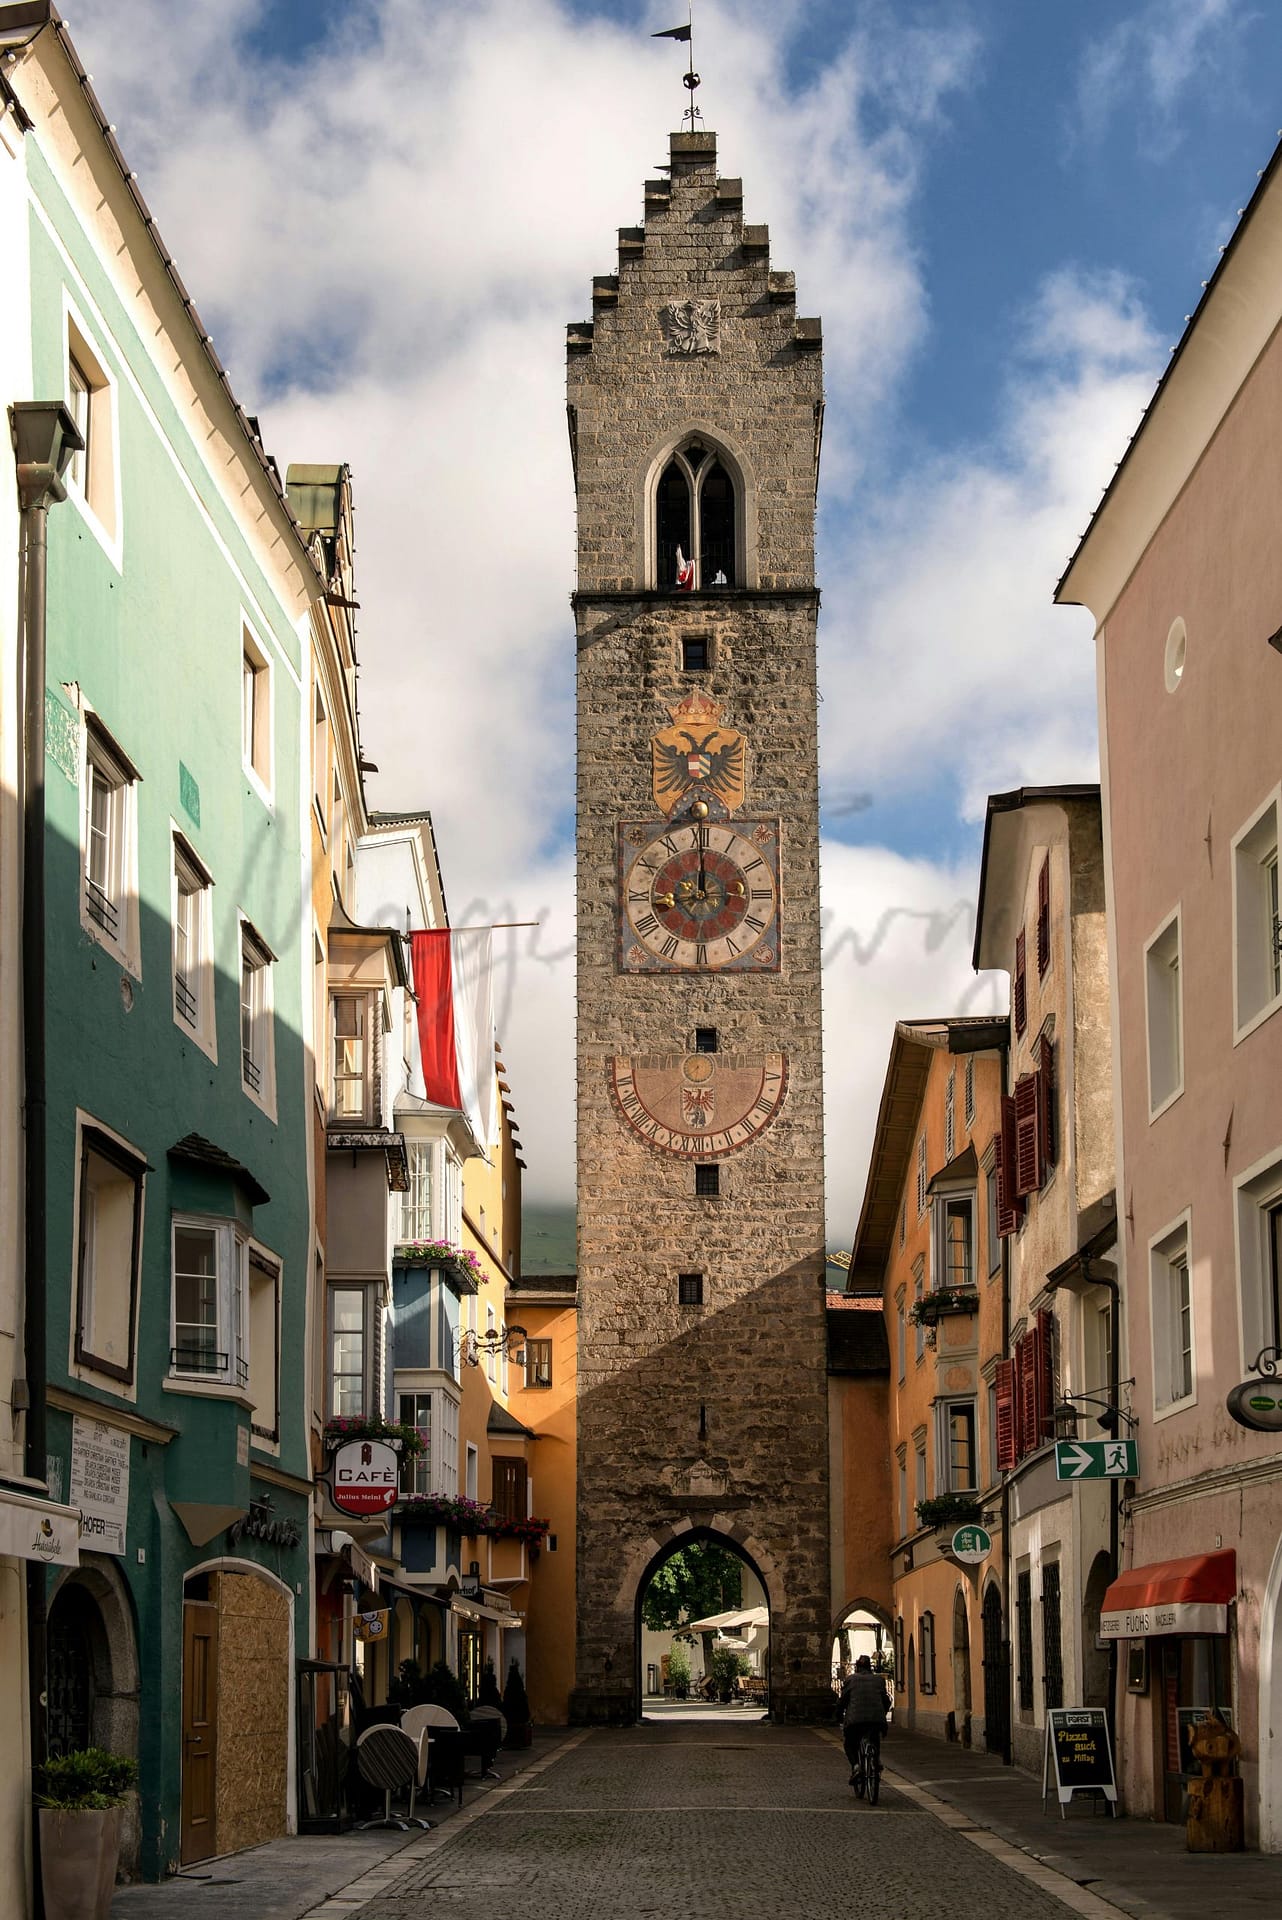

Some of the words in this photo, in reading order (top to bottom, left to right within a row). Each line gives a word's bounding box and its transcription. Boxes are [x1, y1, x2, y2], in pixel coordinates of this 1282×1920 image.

[658, 835, 679, 857] XI
[637, 857, 659, 876] X
[743, 857, 764, 873] II
[629, 889, 650, 902] IX
[751, 889, 772, 899] III
[635, 914, 660, 939] VIII
[744, 914, 766, 934] IV
[660, 935, 679, 960] VII
[696, 944, 708, 964] VI
[726, 936, 741, 957] V
[617, 1075, 633, 1087] VI
[766, 1071, 781, 1081] V
[622, 1092, 638, 1110] VII
[631, 1107, 649, 1128] VIII
[741, 1118, 756, 1134] III
[647, 1123, 662, 1142] IX
[666, 1133, 677, 1148] X
[723, 1130, 733, 1146] II
[679, 1136, 690, 1151] XI
[691, 1138, 704, 1153] XII
[83, 1515, 105, 1535] HOFER
[1126, 1614, 1150, 1633] FUCHS
[1058, 1731, 1088, 1742] Pizza
[1074, 1741, 1096, 1751] auch
